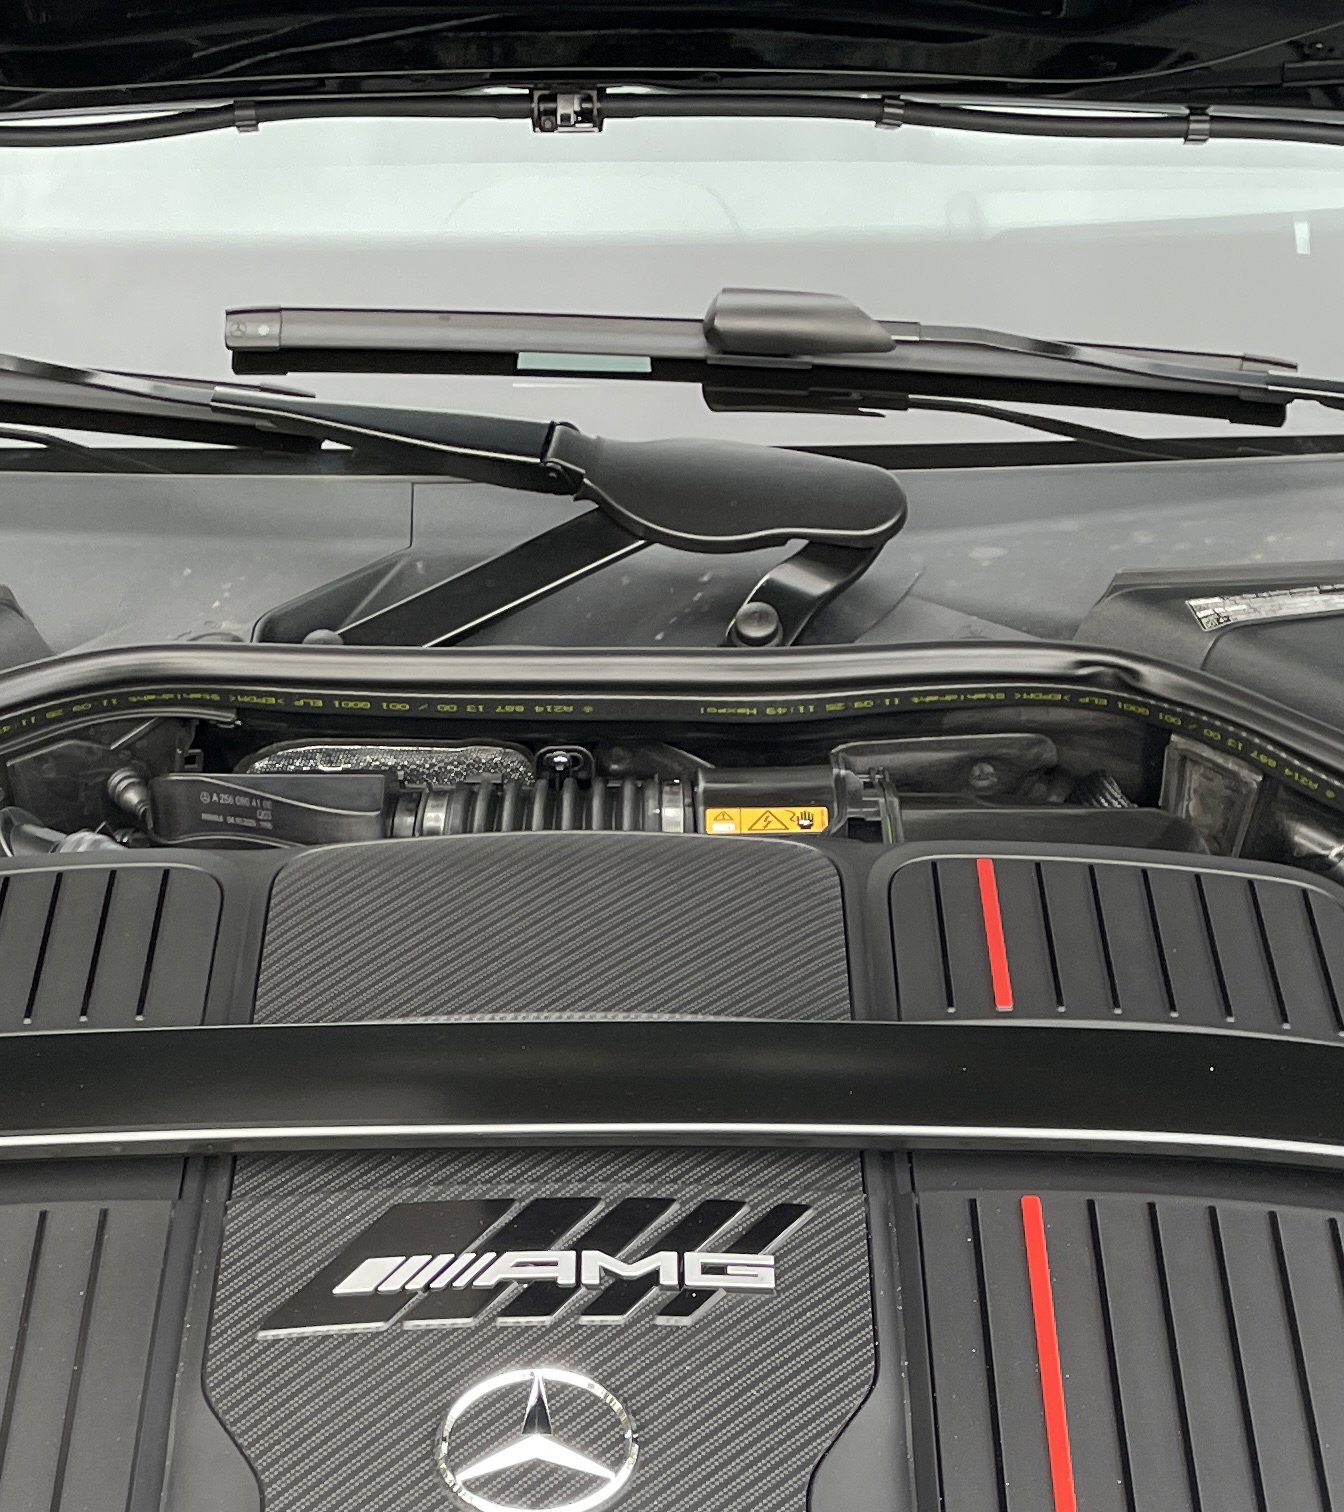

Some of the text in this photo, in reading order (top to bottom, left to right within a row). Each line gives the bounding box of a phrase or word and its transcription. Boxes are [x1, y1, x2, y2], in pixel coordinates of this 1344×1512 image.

[293, 698, 324, 708] ELP
[535, 704, 574, 714] A214
[700, 706, 757, 716] Hexpol
[473, 1249, 776, 1290] AMG
